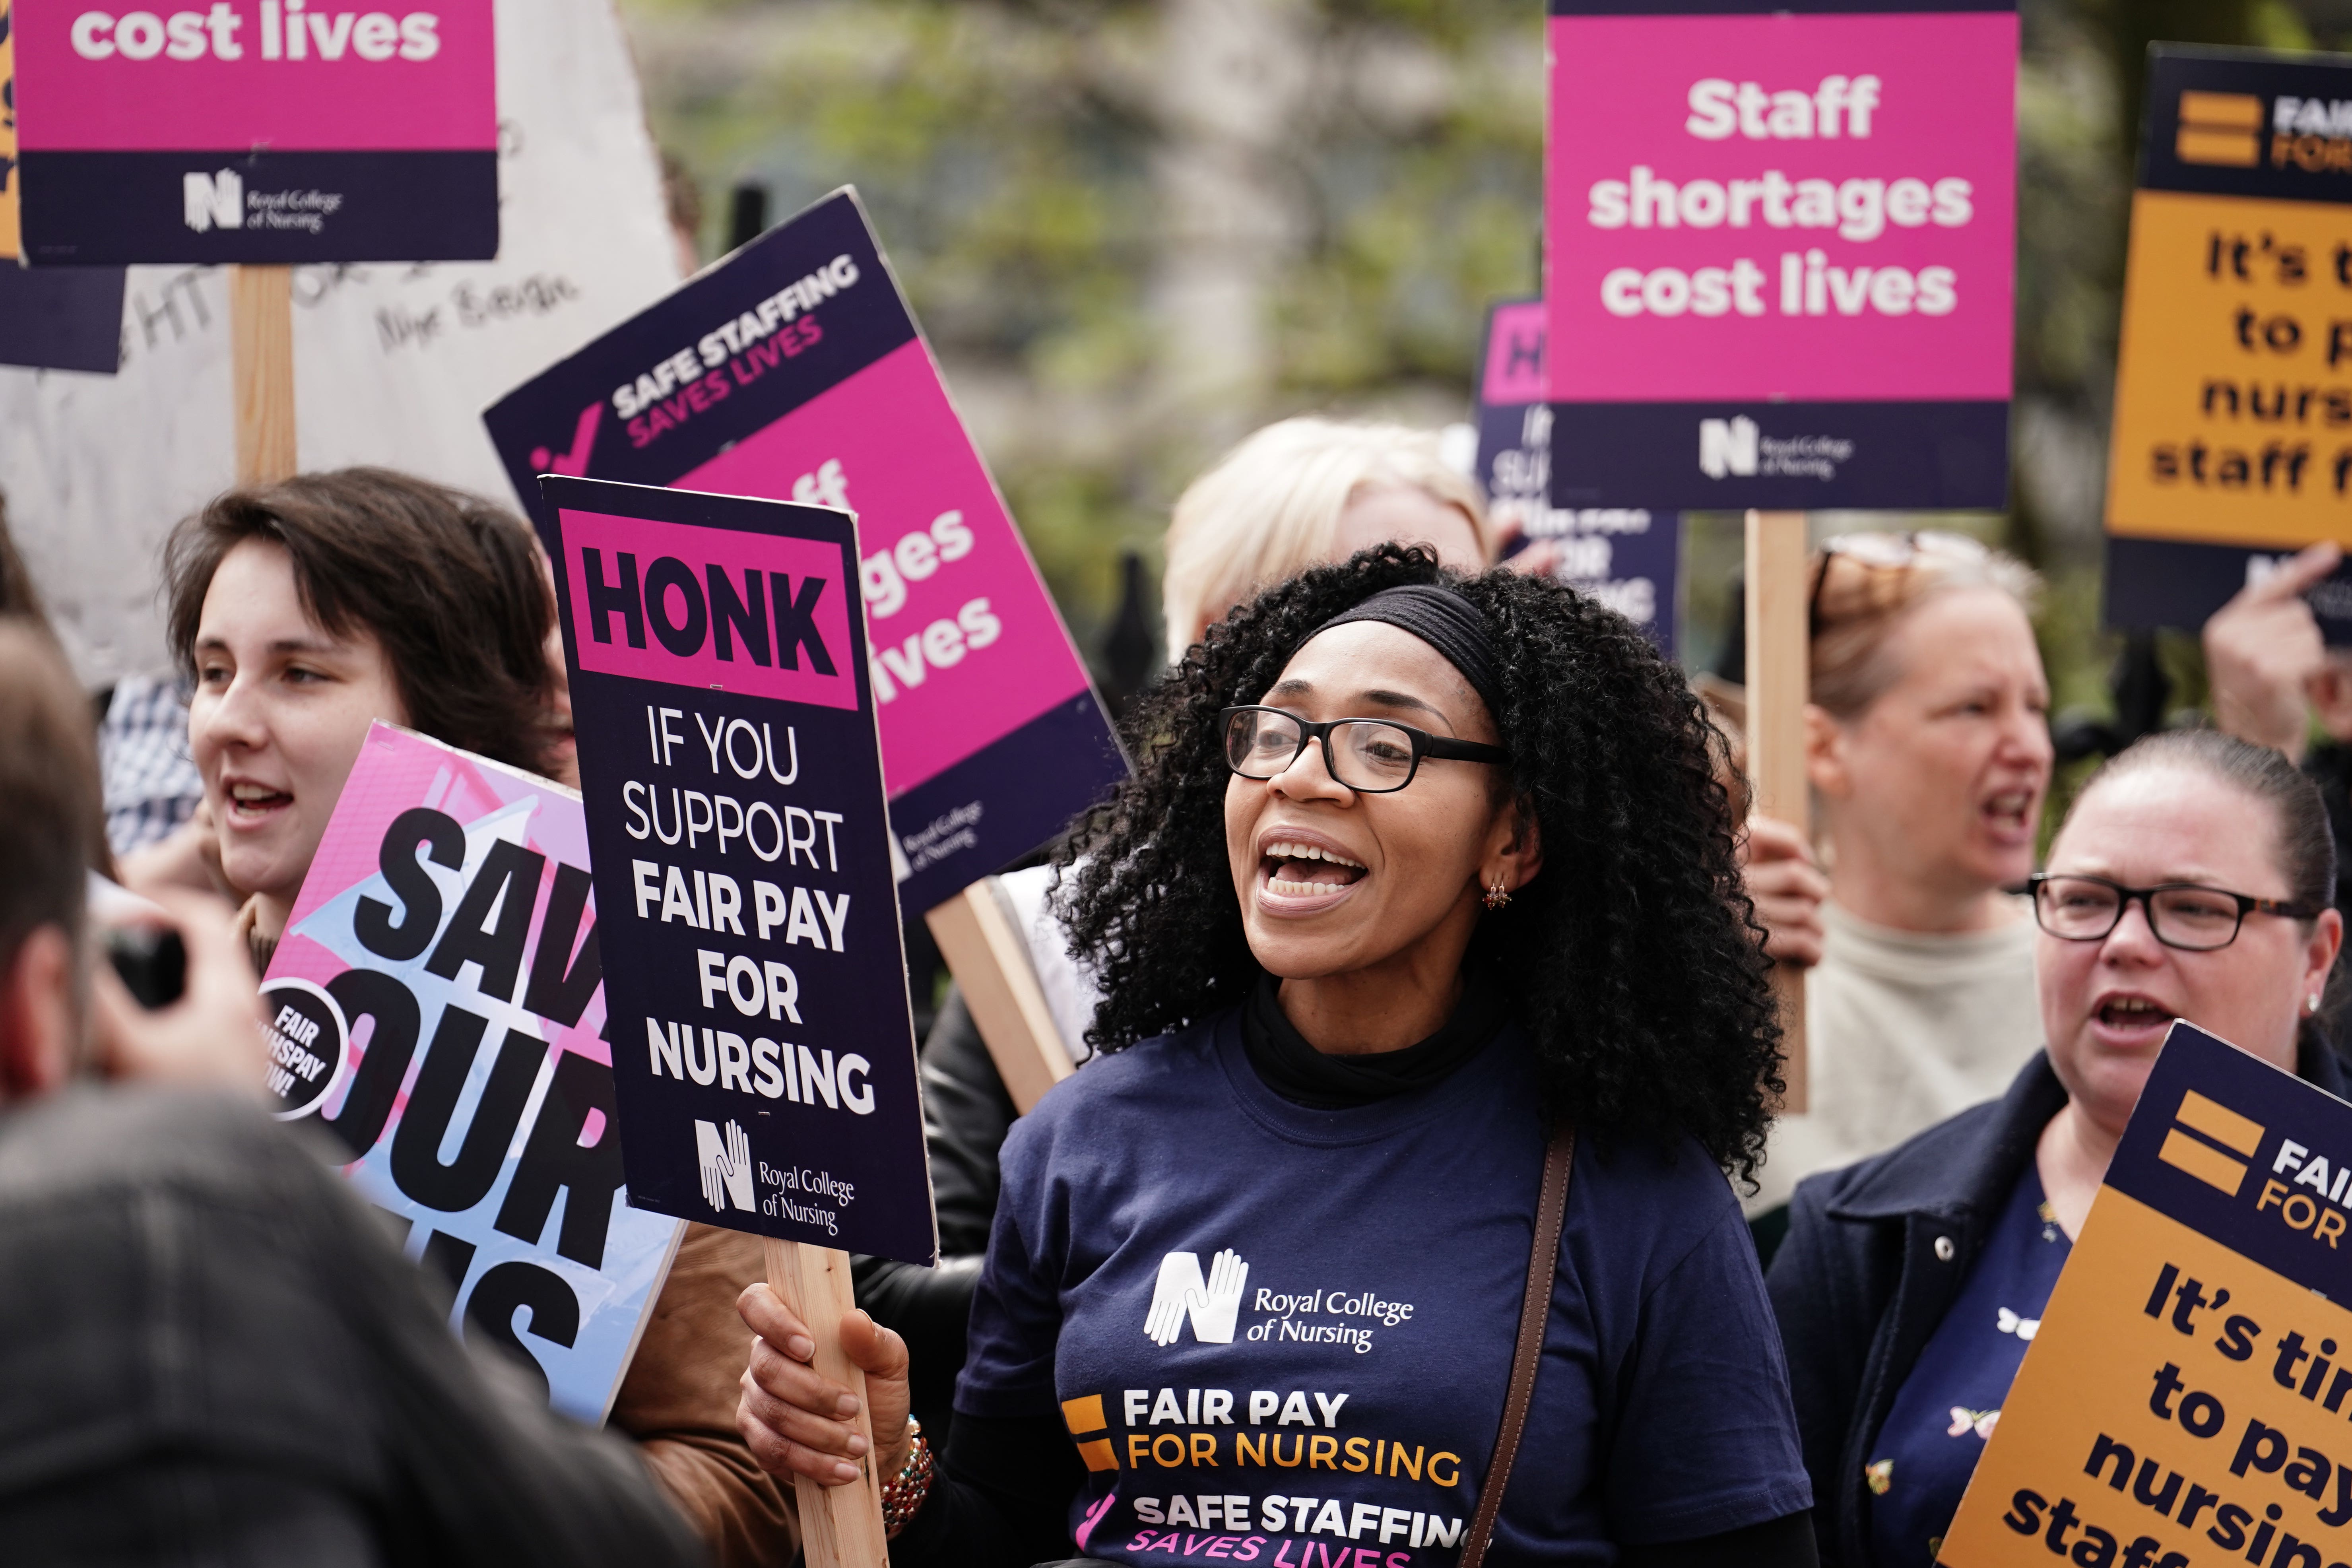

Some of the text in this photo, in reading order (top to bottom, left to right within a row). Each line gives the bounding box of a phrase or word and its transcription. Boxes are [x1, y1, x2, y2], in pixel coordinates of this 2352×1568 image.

[71, 0, 441, 61] cost lives
[1684, 74, 1882, 141] Staff
[1587, 165, 1974, 243] shortages
[1600, 248, 1958, 318] cost lives
[612, 253, 860, 421] SAFE STAFFING
[2234, 305, 2303, 355] to
[627, 314, 823, 448] SAVES LIVES
[2146, 437, 2312, 495] staff
[582, 547, 838, 676] HONK
[869, 597, 1001, 704] ives
[647, 706, 798, 785] IF YOU
[623, 780, 843, 872] SUPPORT
[353, 807, 610, 1044] SAV
[632, 859, 850, 952] FAIR PAY
[697, 949, 802, 1024] FOR
[274, 1005, 319, 1048] FAIR
[646, 1018, 875, 1114] NURSING
[760, 1161, 854, 1205] Royal College
[2272, 1138, 2352, 1209] FAI
[763, 1193, 838, 1236] of Nursing
[2256, 1178, 2346, 1250] FOR
[1248, 1319, 1373, 1353] of Nursing
[1254, 1288, 1414, 1326] Royal College
[1124, 1388, 1349, 1429] FAIR PAY
[2149, 1362, 2225, 1439] to
[1128, 1434, 1461, 1488] FOR NURSING
[1133, 1495, 1251, 1531] SAFE
[2083, 1432, 2352, 1568] nursin
[1126, 1530, 1266, 1560] SAVES
